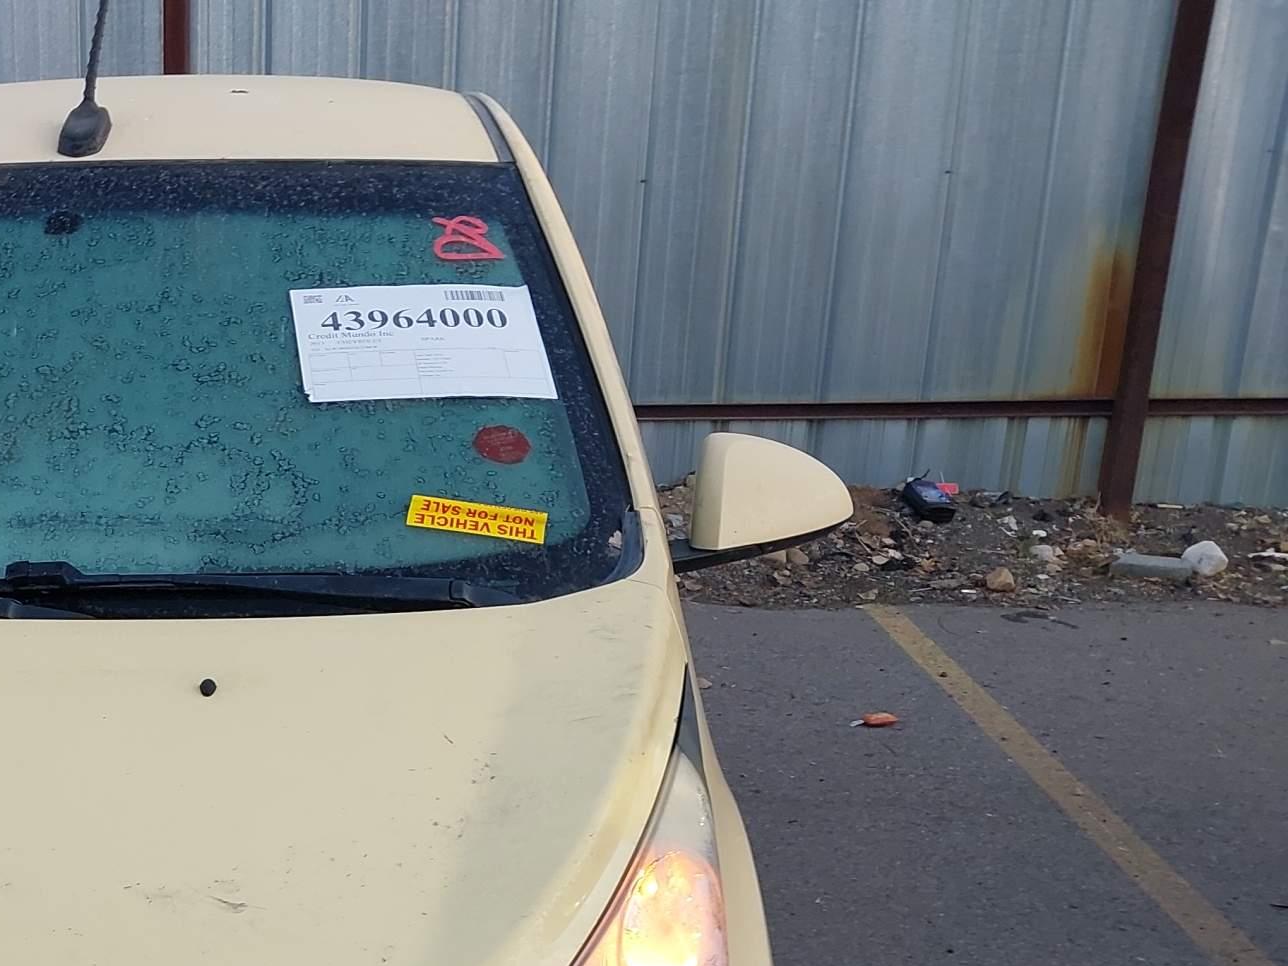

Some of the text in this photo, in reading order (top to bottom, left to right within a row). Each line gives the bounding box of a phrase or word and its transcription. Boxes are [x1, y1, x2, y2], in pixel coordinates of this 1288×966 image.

[321, 307, 508, 331] 43964000
[414, 513, 537, 540] THIS VEHICLE
[421, 499, 536, 527] NOT FOR SALE
